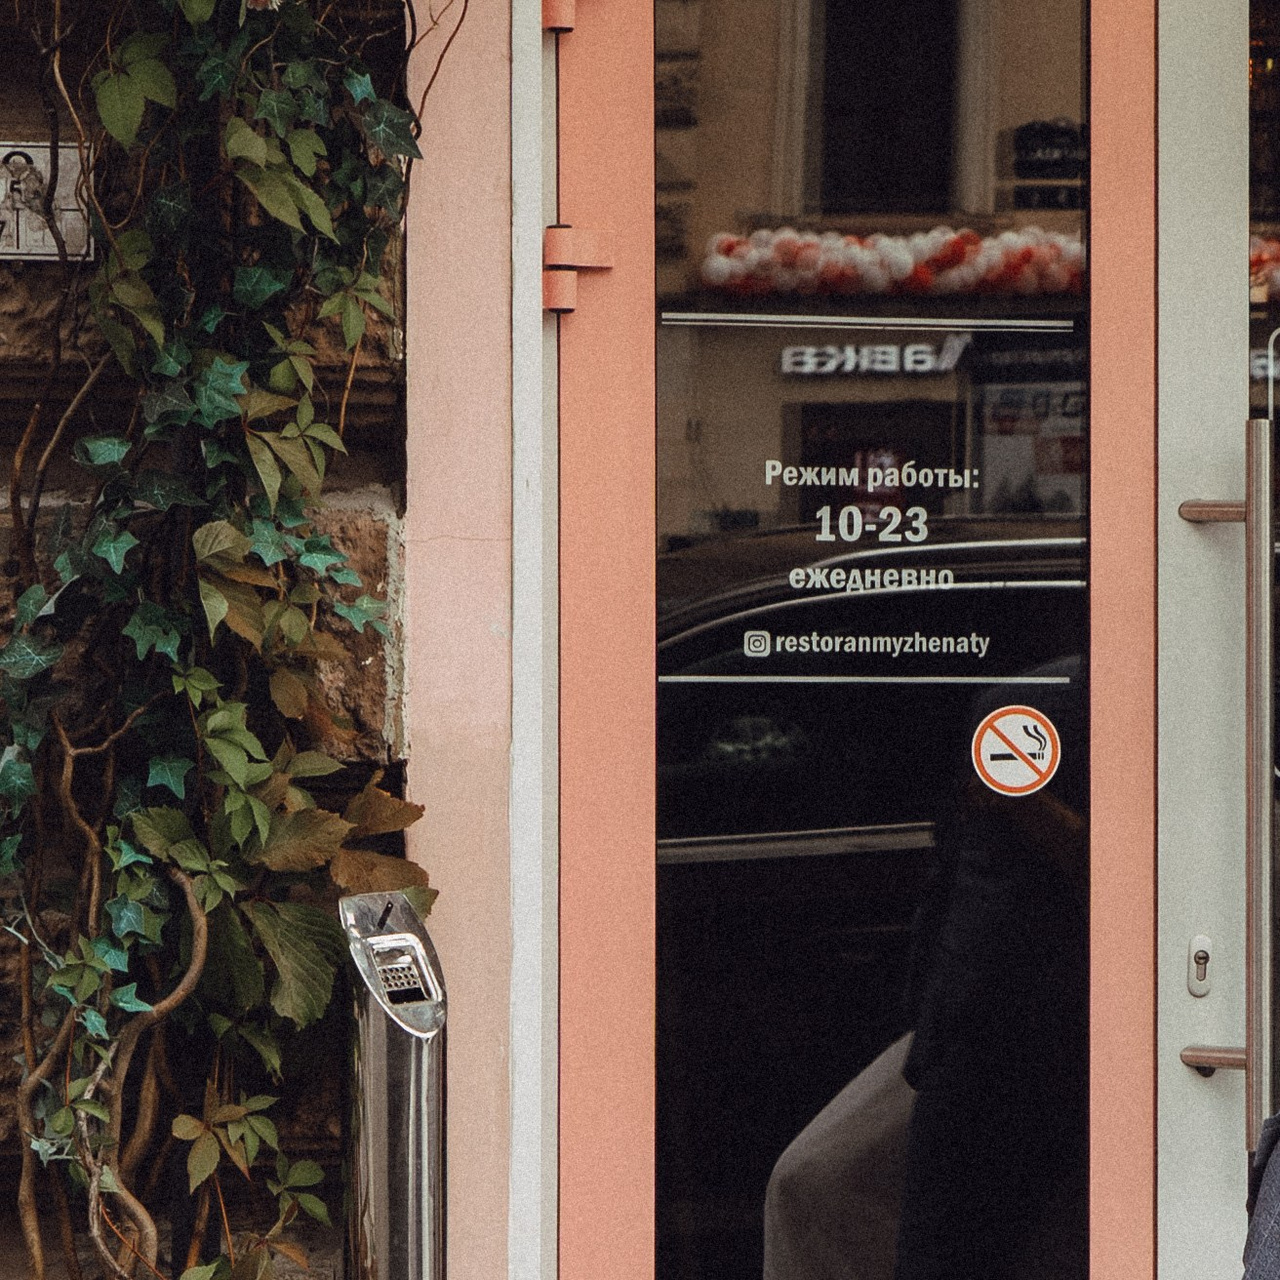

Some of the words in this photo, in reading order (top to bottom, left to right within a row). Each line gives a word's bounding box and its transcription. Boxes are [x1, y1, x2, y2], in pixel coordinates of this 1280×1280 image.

[764, 459, 860, 486] Режим
[866, 460, 980, 492] работы:
[815, 505, 929, 543] 10-23
[788, 567, 955, 593] ежедневно
[776, 631, 990, 658] restoranmyzhenaty
